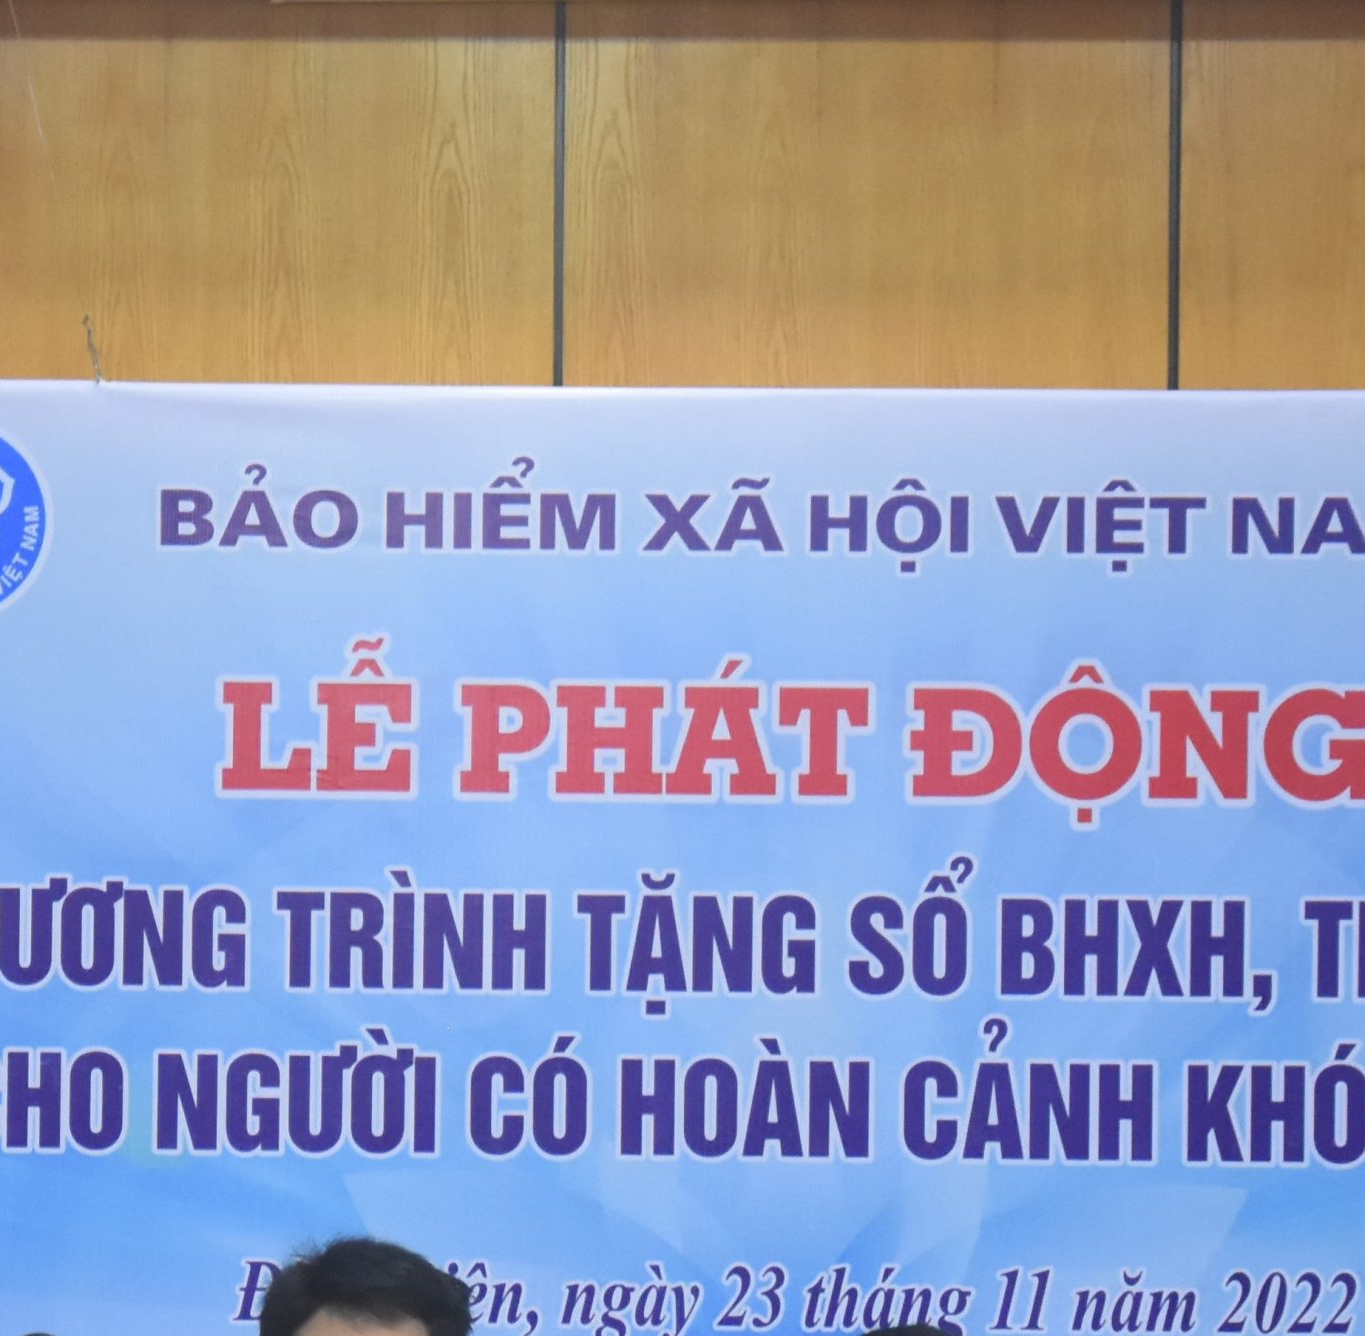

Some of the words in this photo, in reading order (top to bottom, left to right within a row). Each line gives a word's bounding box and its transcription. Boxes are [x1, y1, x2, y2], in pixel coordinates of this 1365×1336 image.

[20, 506, 40, 551] NAM
[161, 463, 357, 549] BẢO
[386, 457, 615, 550] HIỂM
[645, 477, 783, 551] XÃ
[809, 478, 970, 573] HỘI
[995, 479, 1207, 573] VIỆT
[221, 637, 413, 793] LỄ
[459, 658, 870, 797] PHÁT
[276, 868, 548, 991] TRÌNH
[576, 873, 817, 1016] TẶNG
[847, 855, 974, 997] SỔ
[999, 897, 1273, 1011] BHXH,
[155, 1027, 437, 1155] NGƯỜI
[469, 1035, 589, 1157] CÓ
[619, 1037, 871, 1159] HOÀN
[902, 1017, 1154, 1162] CẢNH
[717, 1265, 786, 1329] 23
[804, 1266, 972, 1336] tháng
[990, 1270, 1051, 1332] 11
[1071, 1271, 1197, 1334] năm
[1217, 1270, 1358, 1335] 2022
